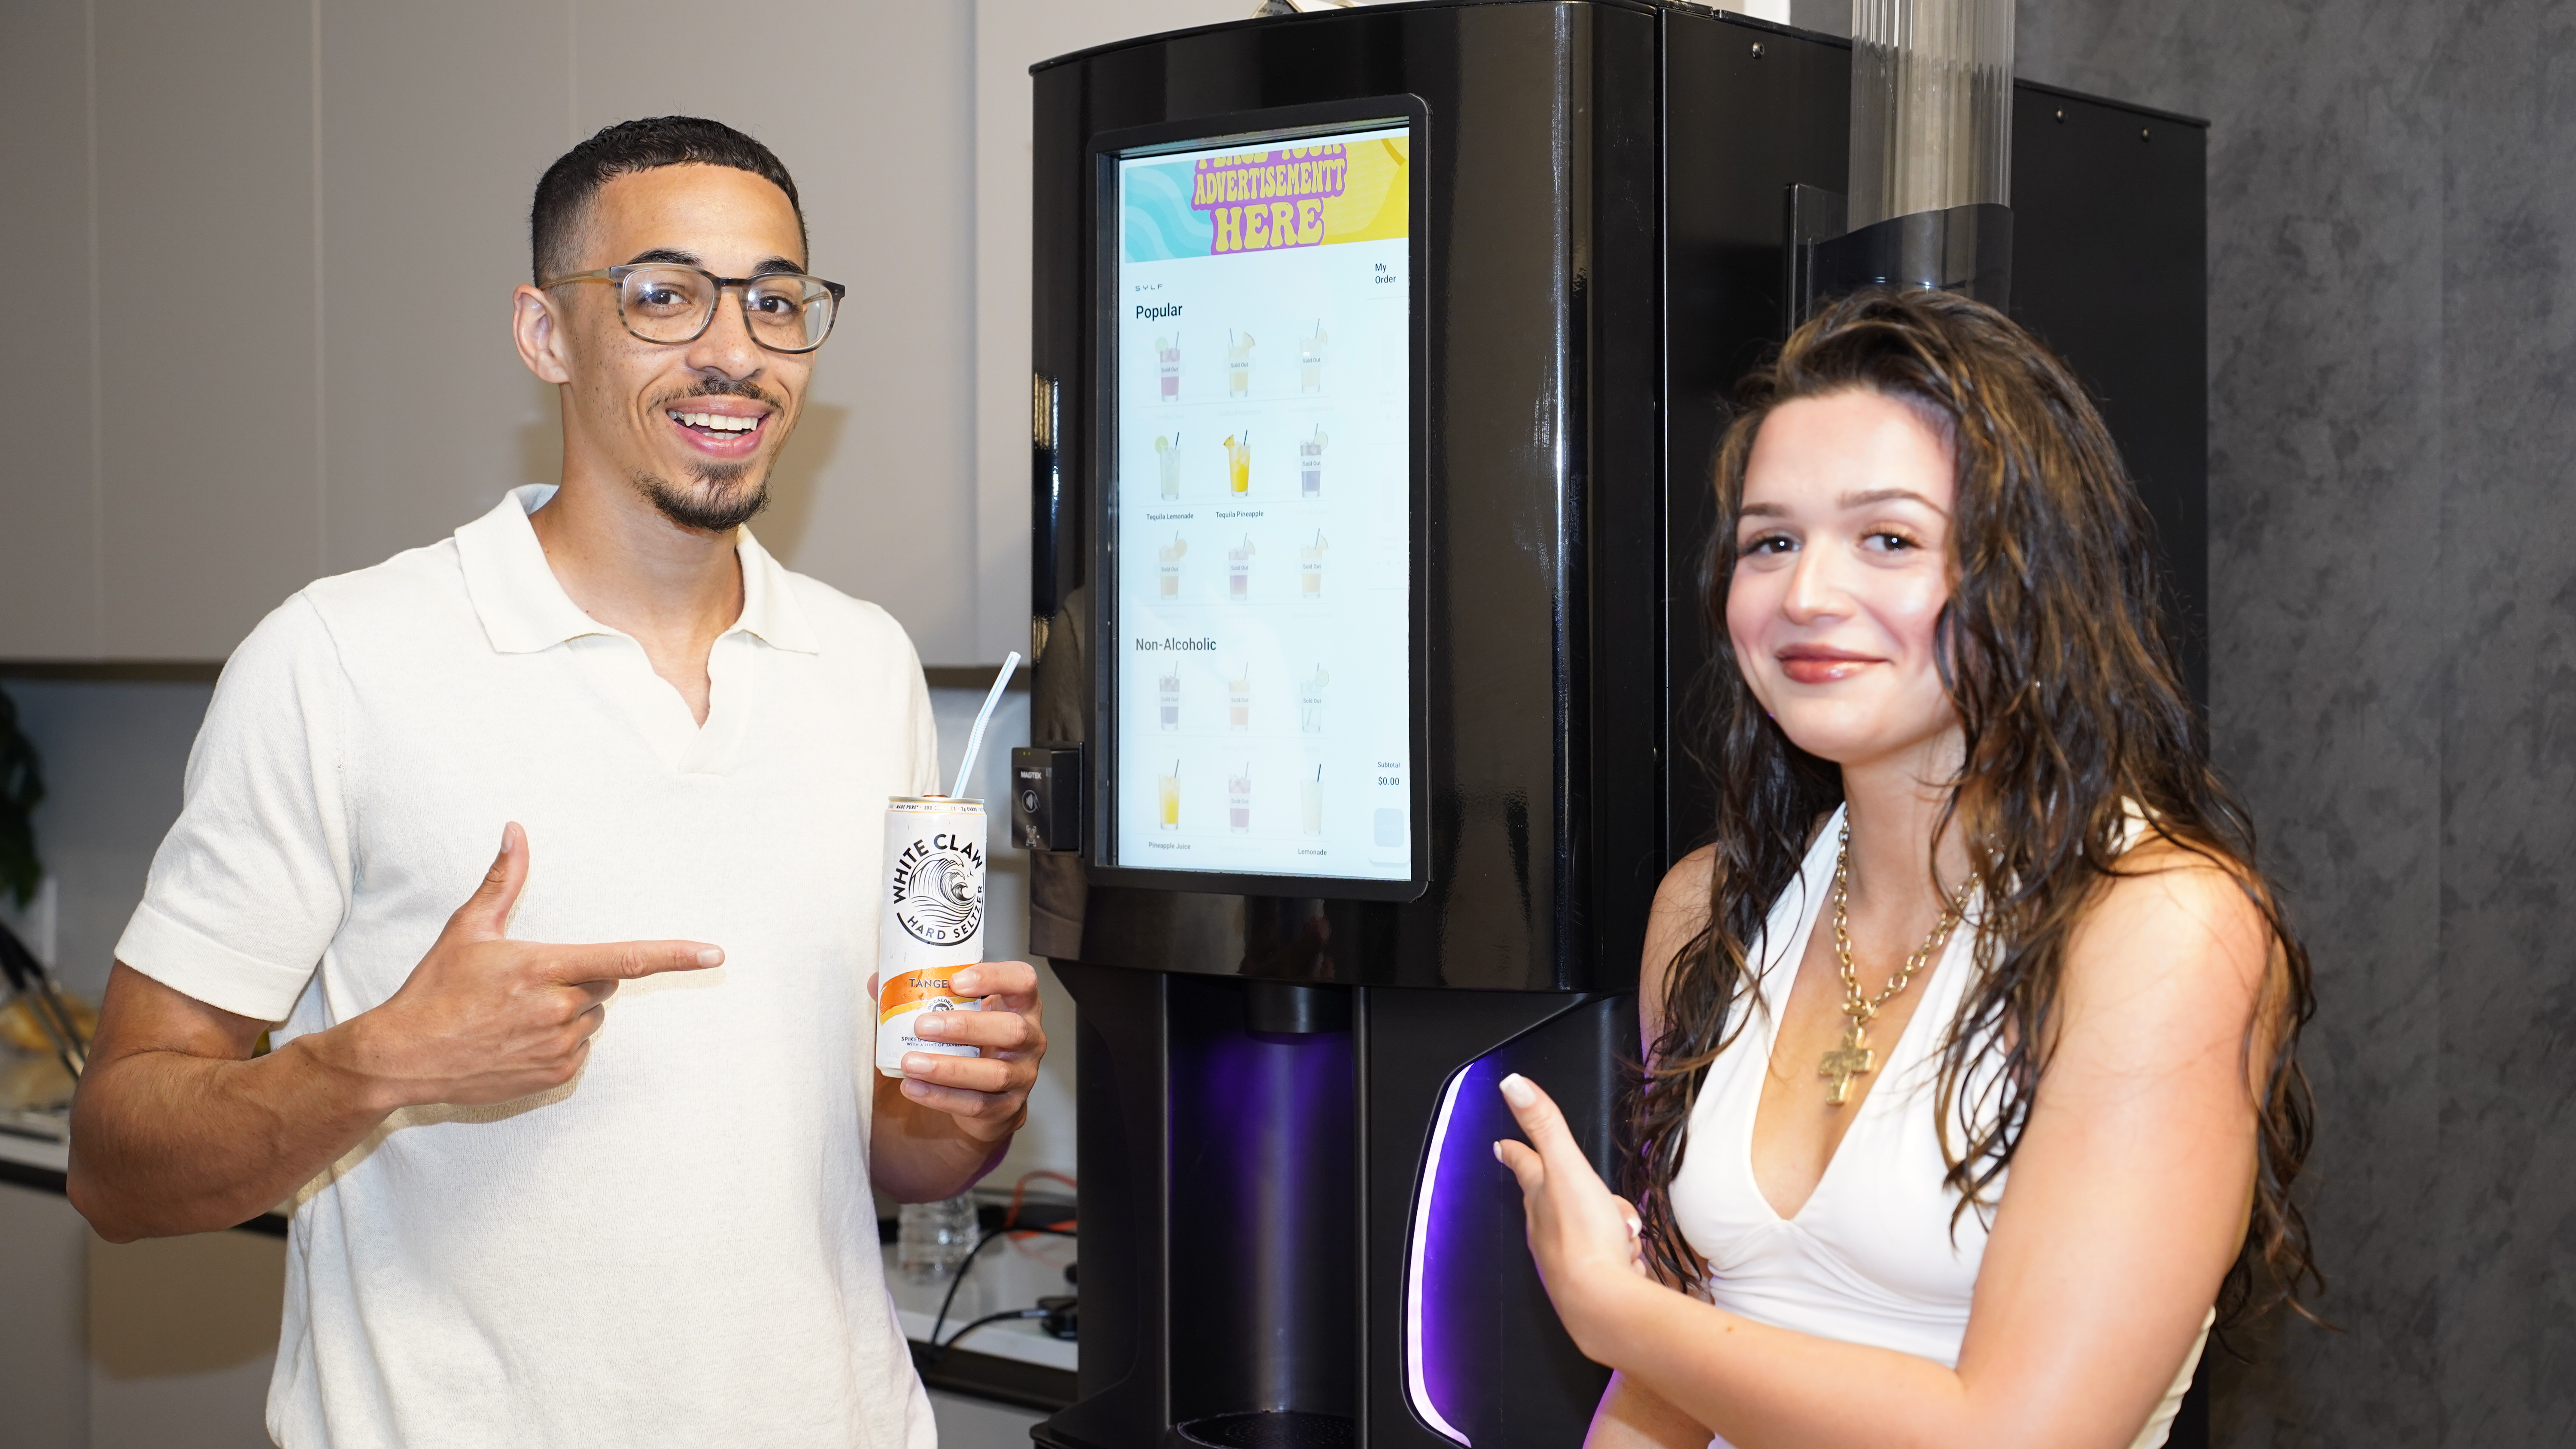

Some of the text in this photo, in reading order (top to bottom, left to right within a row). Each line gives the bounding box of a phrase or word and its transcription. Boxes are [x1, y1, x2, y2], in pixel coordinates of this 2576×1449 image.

[1194, 158, 1346, 205] ADVERTISEMENTT
[1215, 199, 1322, 252] HERE
[1375, 263, 1387, 273] My
[1375, 275, 1396, 284] Order
[1135, 283, 1163, 291] SYLF
[1136, 303, 1183, 321] Popular
[1236, 510, 1264, 518] Pineapple
[1136, 637, 1217, 651] Non-Alcoholic
[1378, 776, 1400, 786] $0.00
[1148, 841, 1174, 850] Pineapple
[893, 834, 983, 904] WHITE CLAW
[907, 885, 982, 940] HARD SELTZER
[909, 978, 950, 988] TANGE
[933, 998, 954, 1011] CALORIES
